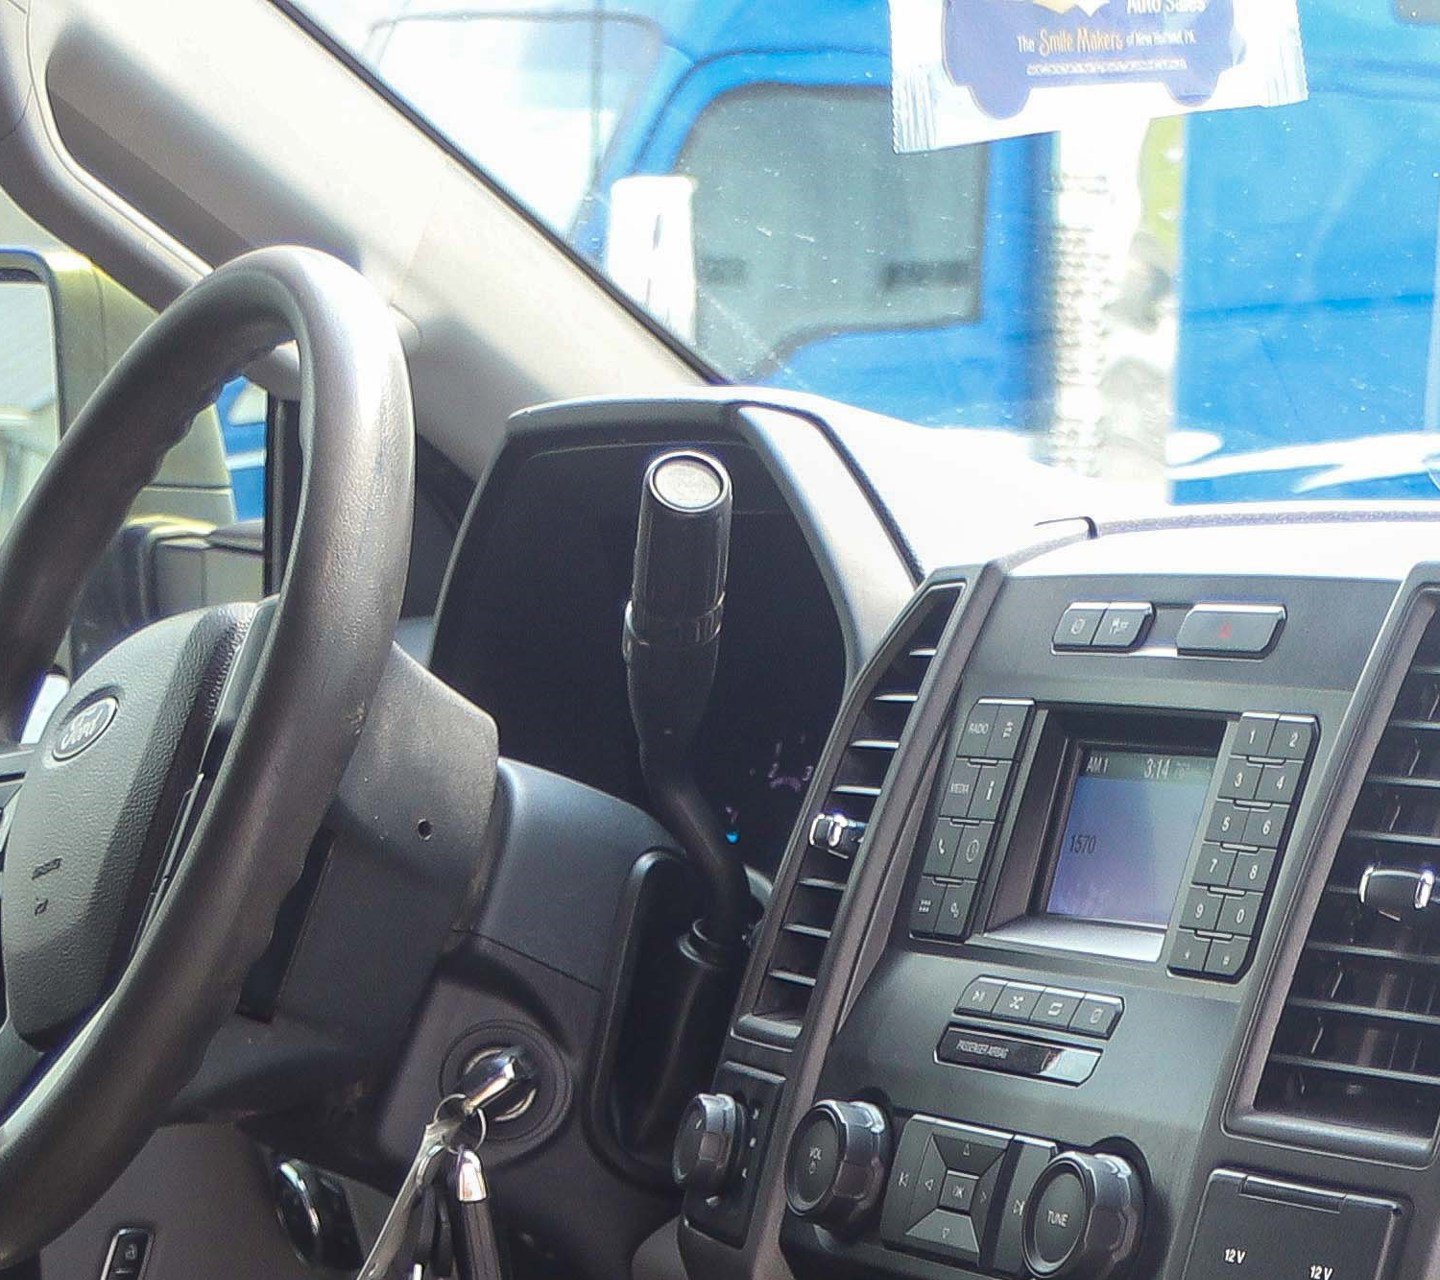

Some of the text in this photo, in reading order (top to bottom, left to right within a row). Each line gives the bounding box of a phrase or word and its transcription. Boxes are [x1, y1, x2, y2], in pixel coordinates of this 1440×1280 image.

[1017, 35, 1035, 53] The
[1039, 28, 1072, 57] Smile
[1076, 27, 1123, 52] Makers
[1248, 729, 1300, 748] 1 2
[1144, 758, 1172, 779] 3:14
[1233, 772, 1286, 790] 3 4
[1221, 815, 1273, 836] 5 6
[1069, 833, 1097, 855] 1570
[1209, 858, 1259, 880] 7 8
[1194, 902, 1246, 924] 9 0
[1046, 1209, 1068, 1228] TUNE
